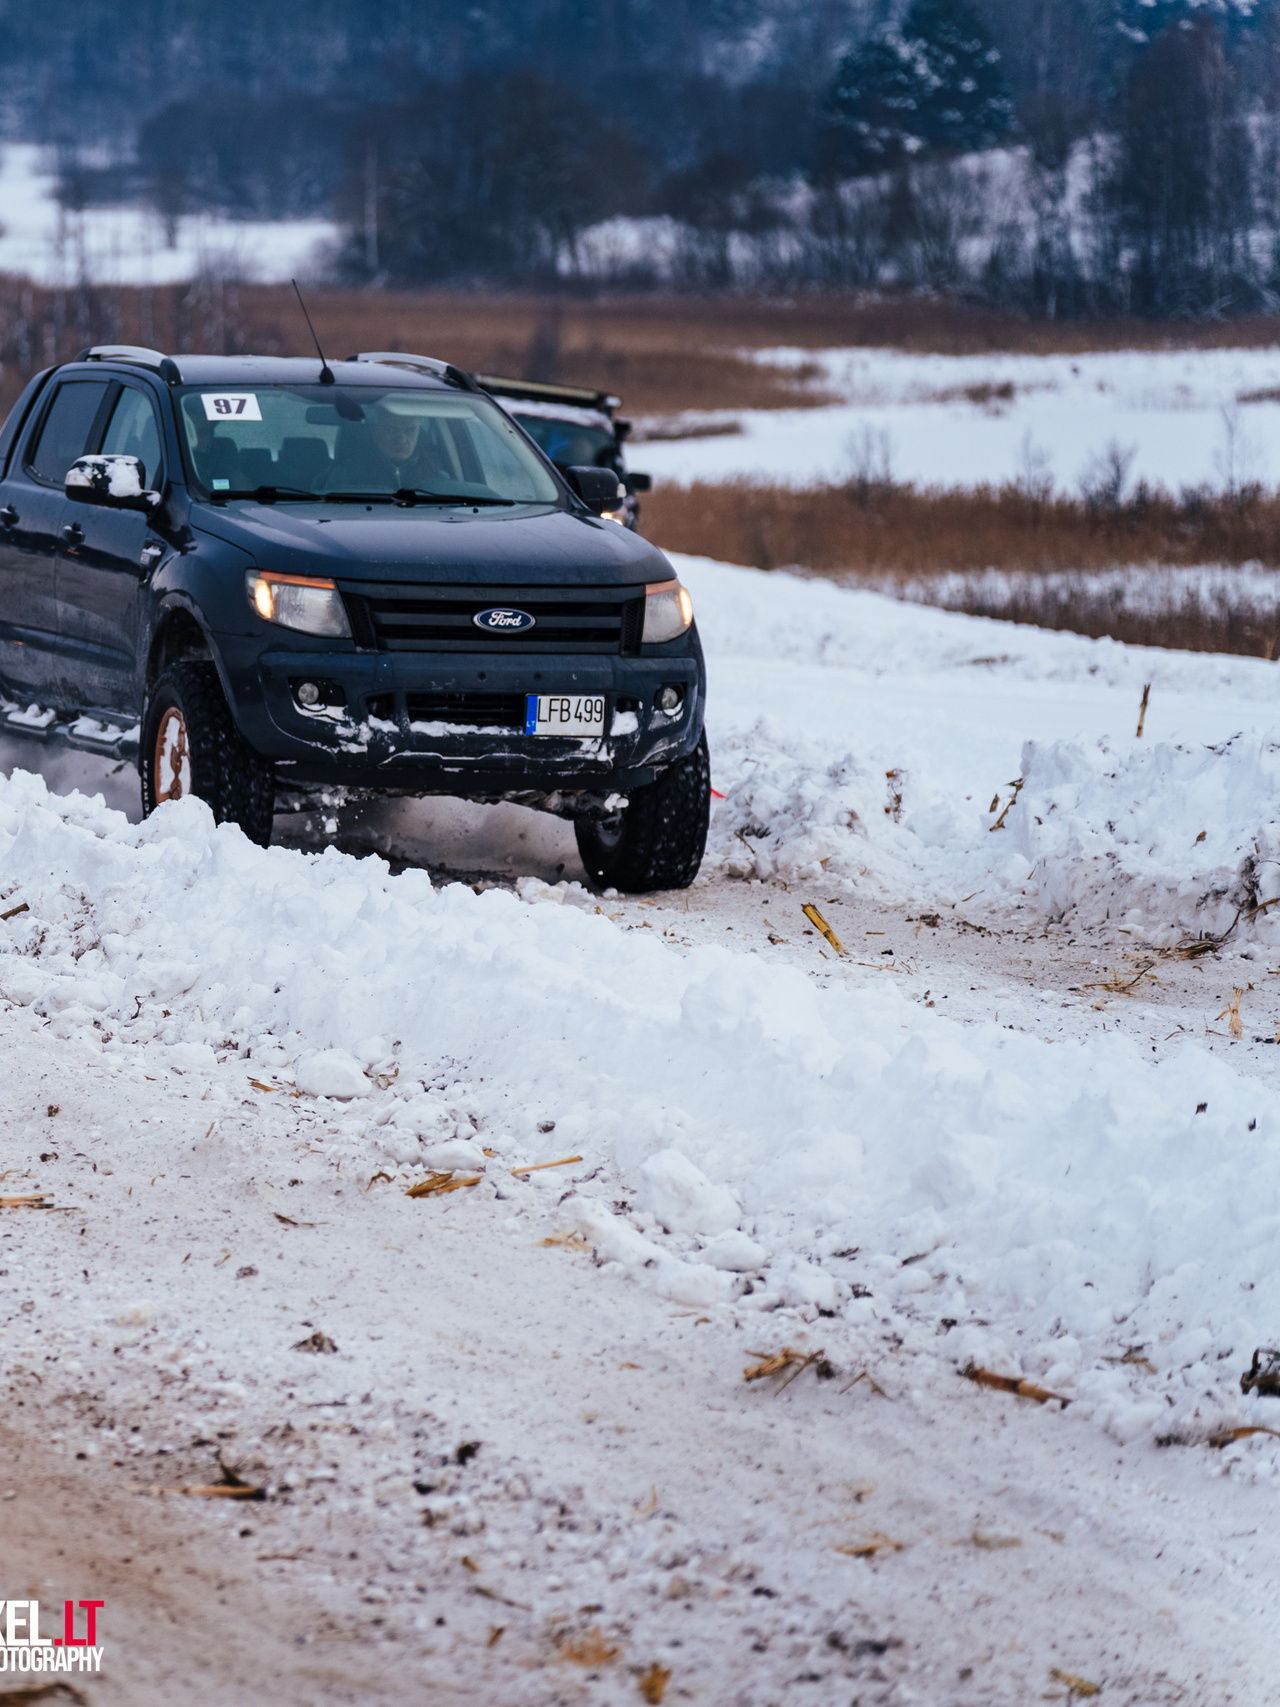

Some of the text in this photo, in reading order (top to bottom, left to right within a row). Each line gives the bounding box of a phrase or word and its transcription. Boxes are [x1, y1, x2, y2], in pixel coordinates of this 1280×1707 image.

[213, 398, 247, 415] 97
[488, 611, 522, 626] Ford
[537, 698, 571, 723] LFB
[574, 698, 603, 723] 499
